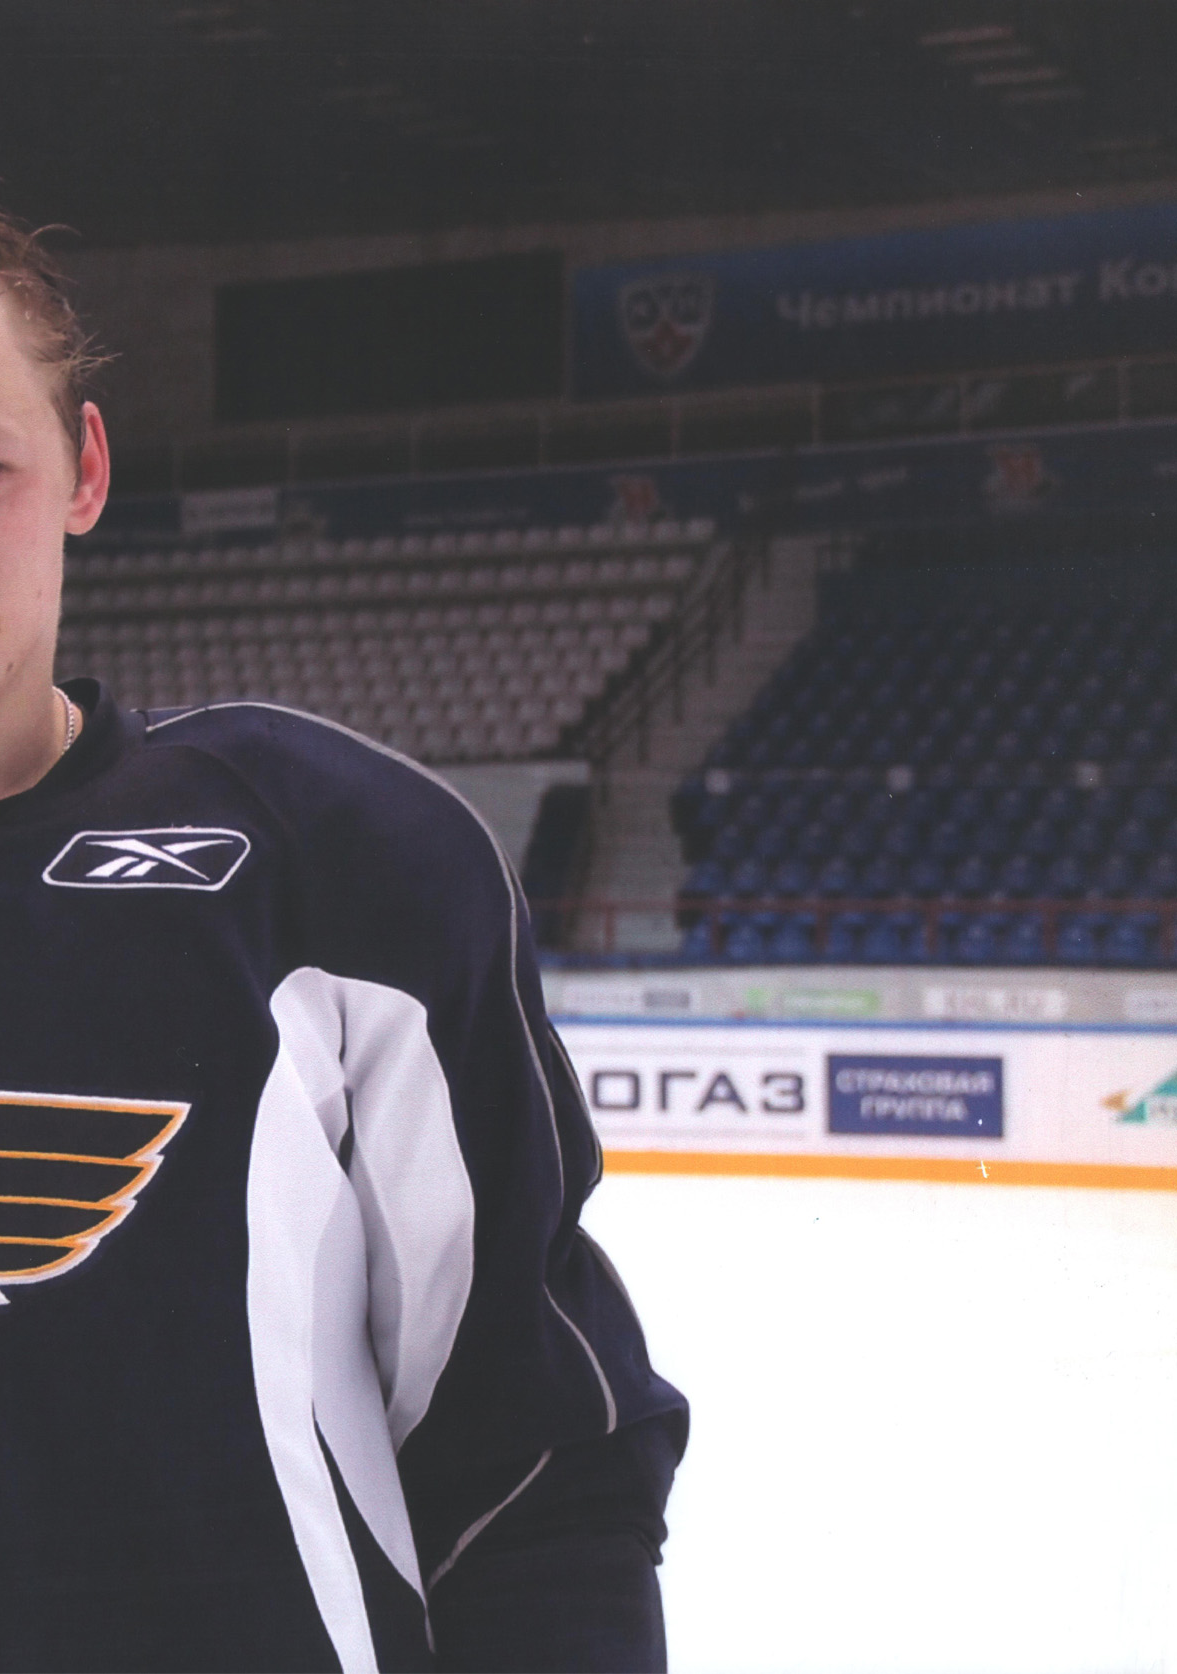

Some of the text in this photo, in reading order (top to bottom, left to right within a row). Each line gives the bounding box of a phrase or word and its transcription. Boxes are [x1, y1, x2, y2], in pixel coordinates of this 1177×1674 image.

[776, 255, 1177, 331] Чемпионат Ко
[836, 1070, 994, 1094] СТРАХОВАЯ
[860, 1096, 968, 1121] ГРУППА
